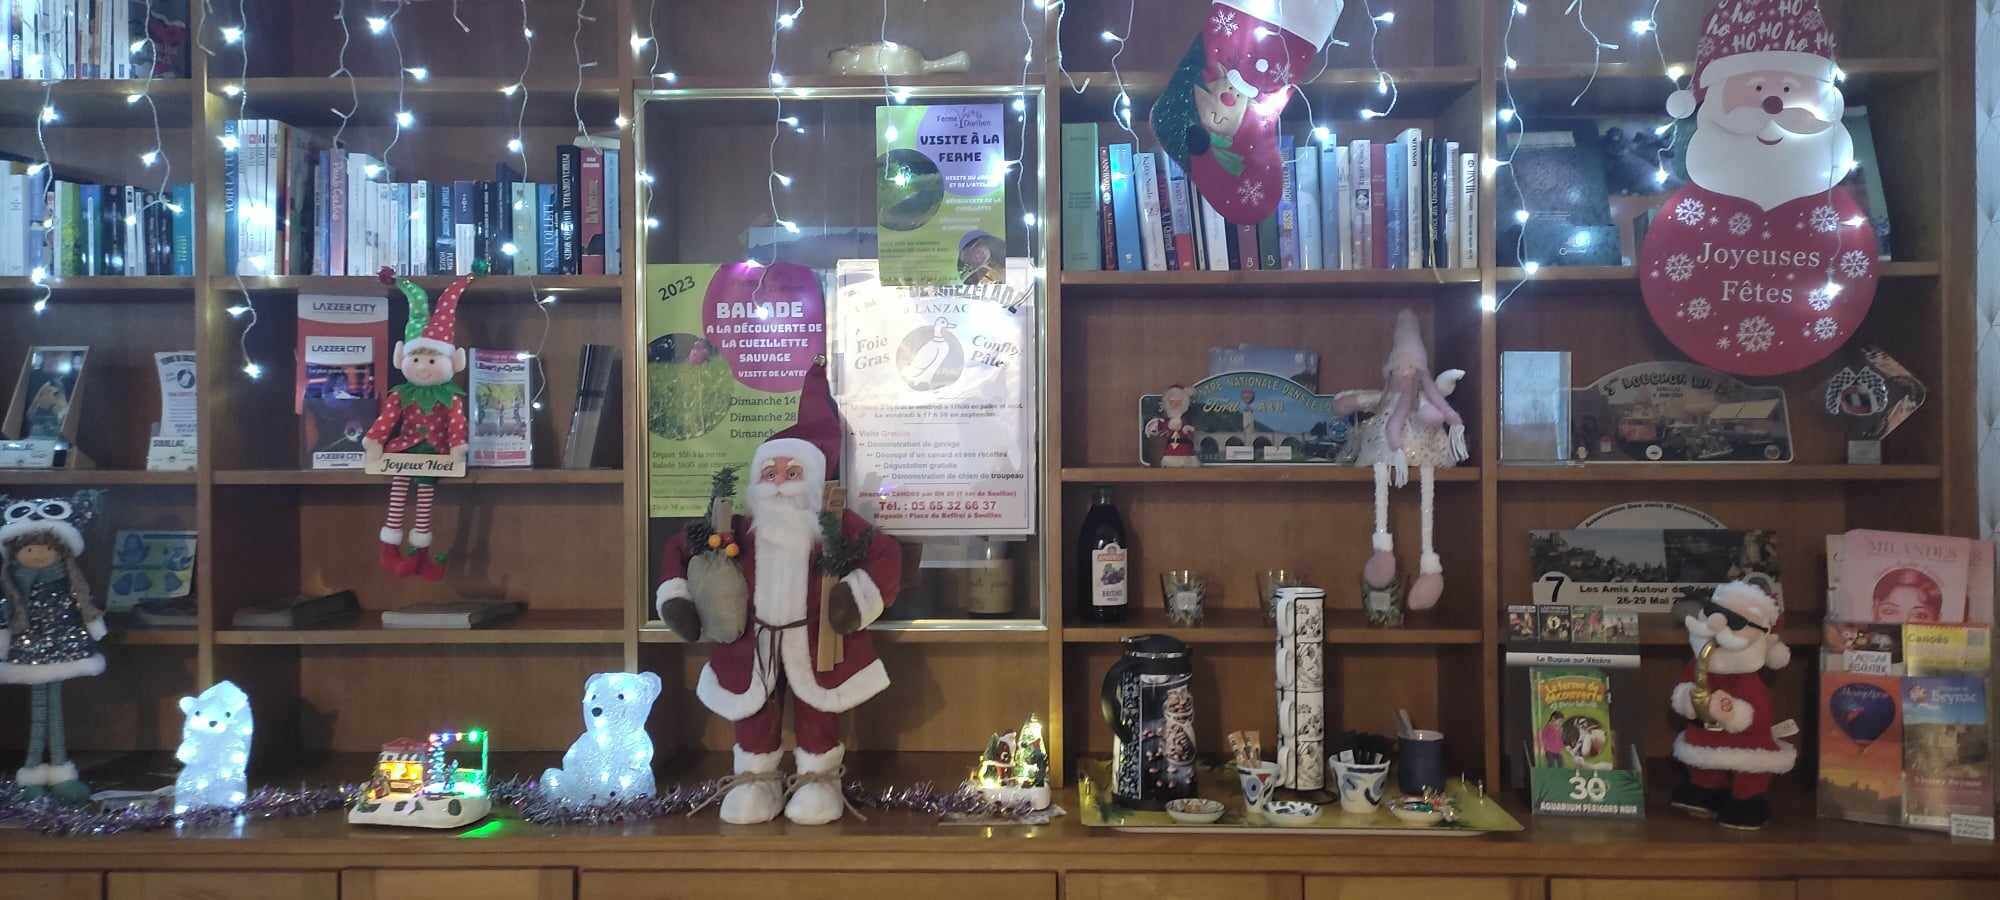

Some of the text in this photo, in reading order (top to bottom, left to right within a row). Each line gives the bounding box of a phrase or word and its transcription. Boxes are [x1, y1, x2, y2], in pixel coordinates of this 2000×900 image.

[1731, 2, 1756, 23] ho
[1707, 14, 1730, 36] ho
[1758, 22, 1783, 40] HO
[1731, 32, 1756, 52] HO
[920, 132, 1000, 145] VISITE À LA
[939, 152, 982, 162] FERME
[543, 204, 554, 269] KEN FOLLETT
[1696, 242, 1821, 270] Joyeuses
[657, 275, 696, 301] 2023
[1720, 280, 1793, 304] Fêtes
[312, 302, 376, 313] LAZZER CITY
[716, 302, 804, 320] BALADE
[706, 322, 823, 334] A LA DÉCOUVERTE DE
[311, 344, 367, 353] LAZZER CITY
[722, 338, 809, 348] LA CUEILLETTE
[857, 335, 889, 353] Foie
[739, 353, 792, 363] SAUVAGE
[854, 353, 890, 370] Gras
[738, 370, 767, 378] VISITE
[768, 370, 780, 378] DE
[730, 396, 796, 406] Dimanche 14
[730, 412, 797, 423] Dimanche 28
[730, 429, 776, 439] Dimanch
[380, 458, 424, 473] Joyeux
[991, 473, 1024, 482] troupeau
[911, 502, 926, 511] 05
[929, 502, 943, 511] 65
[946, 502, 961, 511] 32
[983, 501, 997, 511] 37
[1545, 576, 1565, 603] 7
[1579, 584, 1599, 593] Les
[1602, 584, 1629, 593] Amis
[1632, 584, 1668, 593] Autour
[1616, 596, 1646, 605] 26-29
[1649, 596, 1669, 605] Mai
[1931, 689, 1976, 705] Beynac
[1568, 775, 1607, 802] 30
[1540, 801, 1582, 812] AQUARIUM
